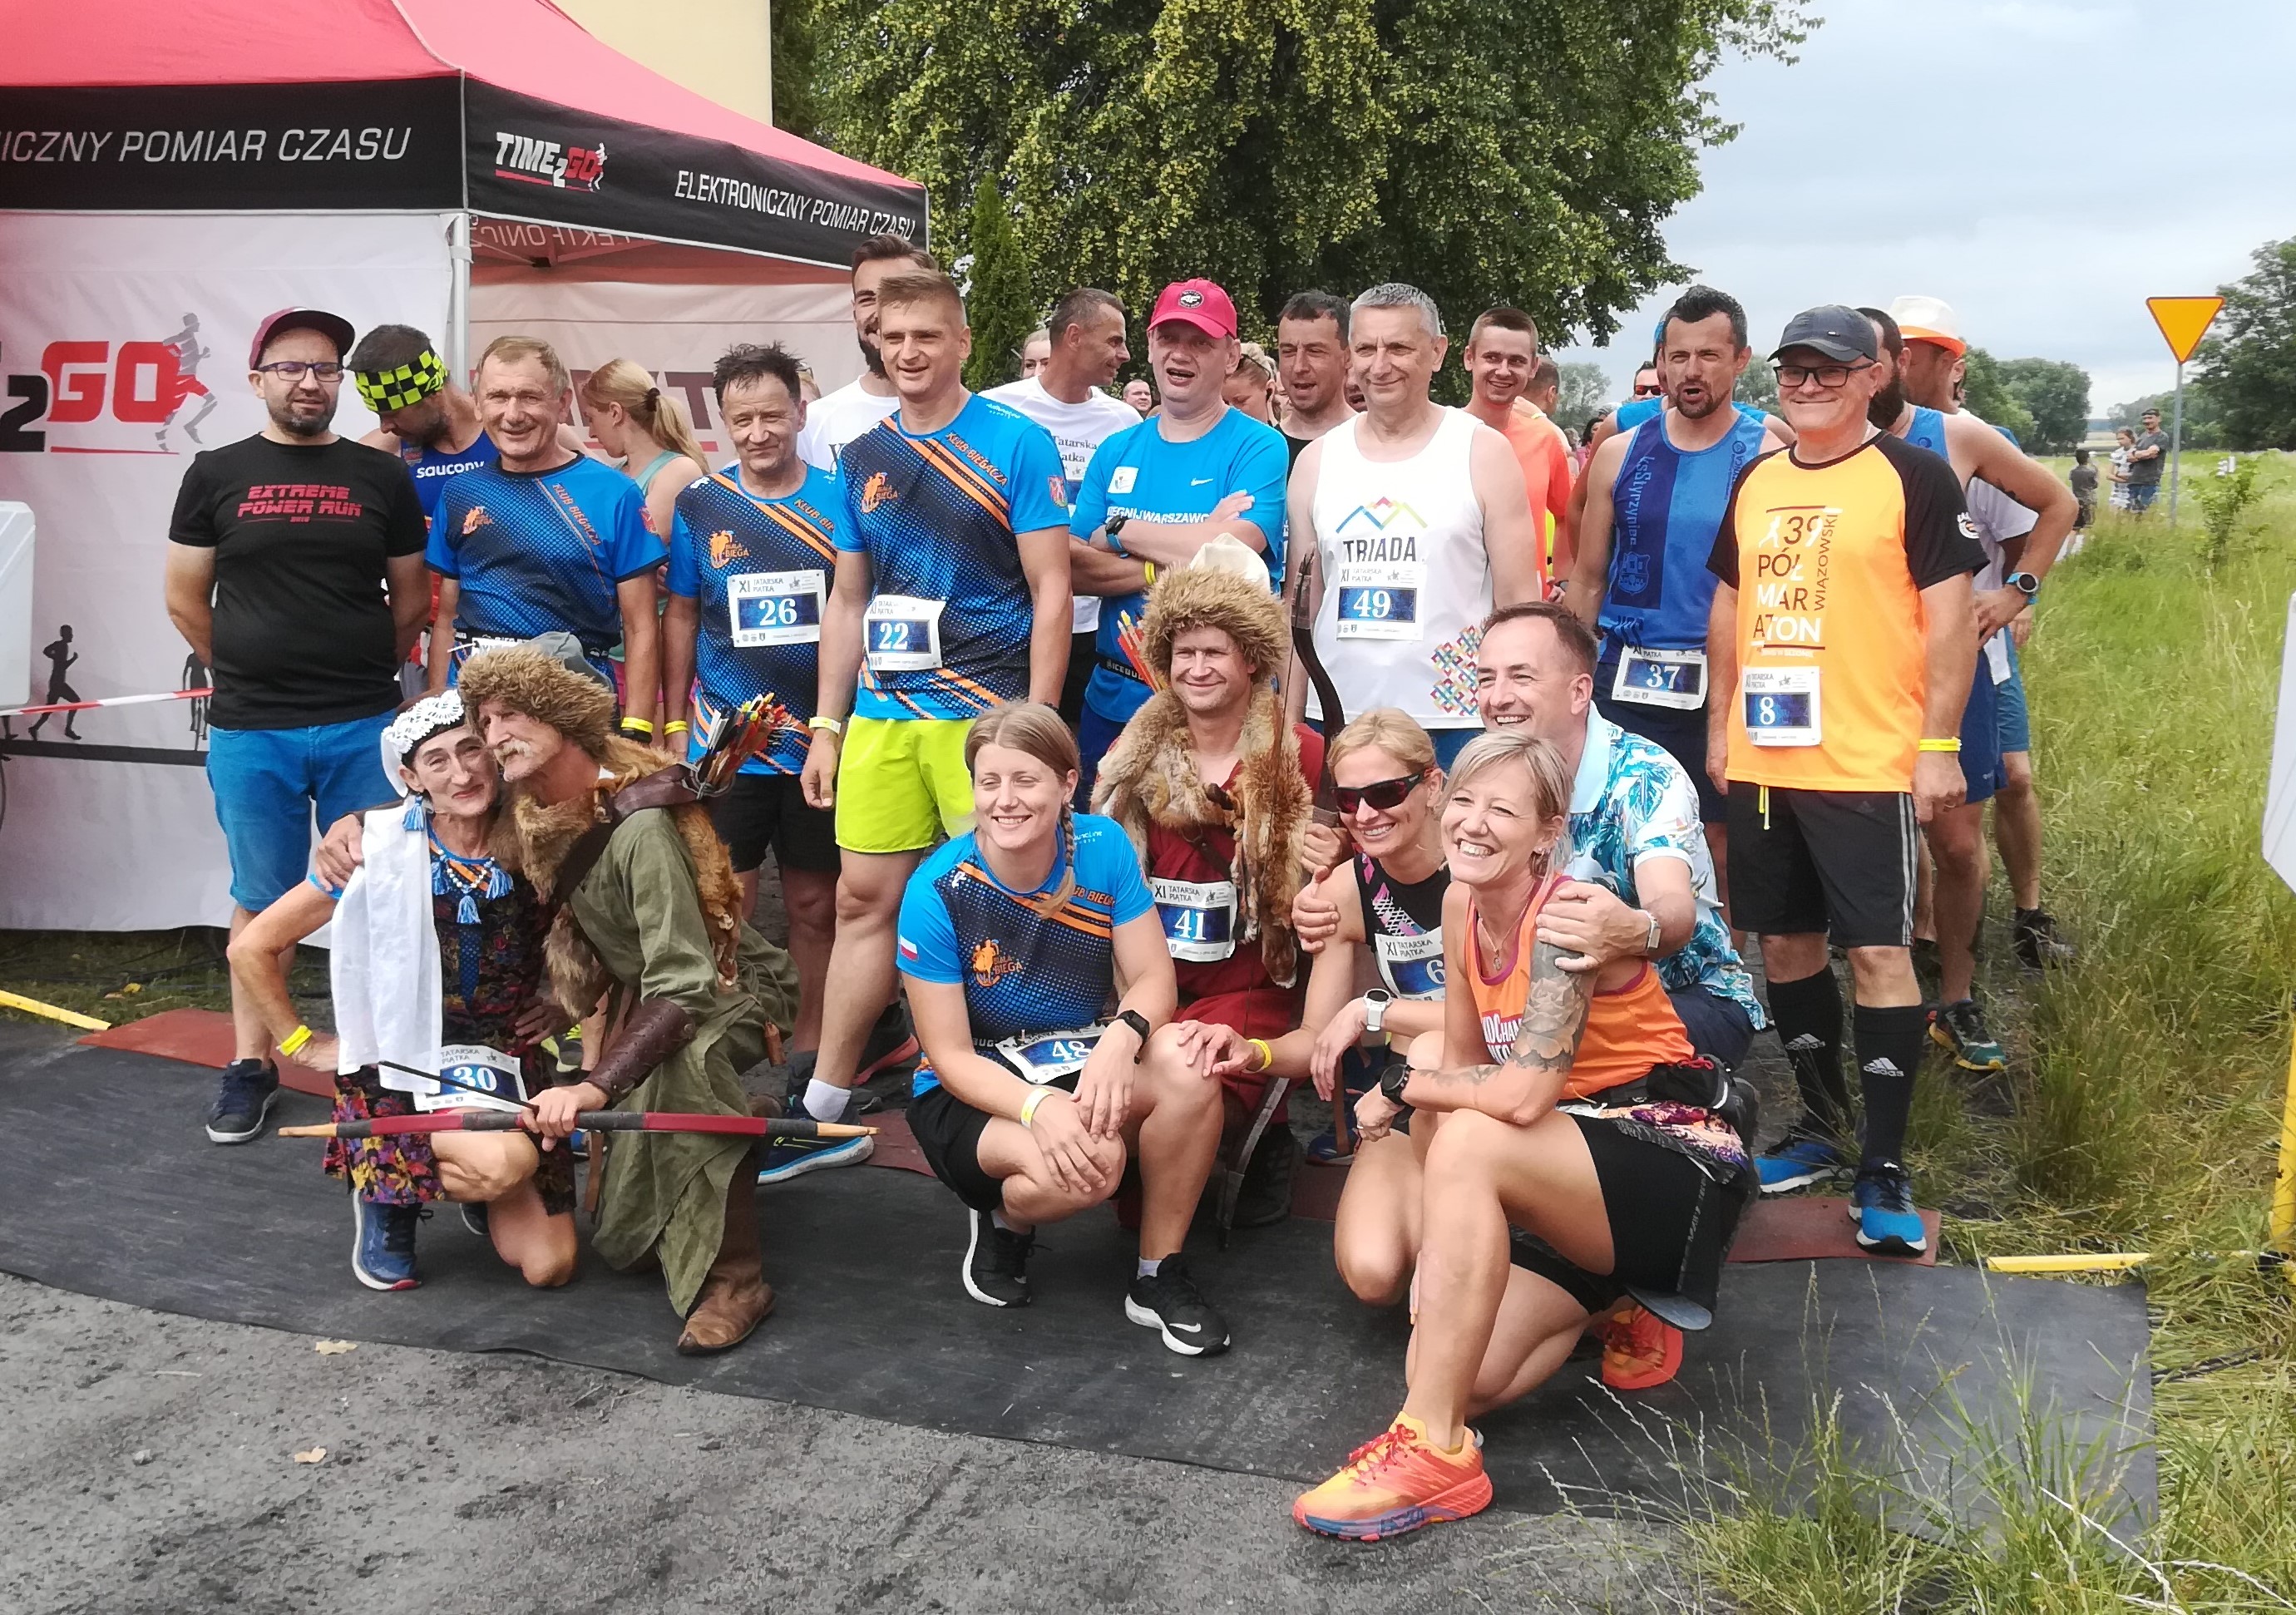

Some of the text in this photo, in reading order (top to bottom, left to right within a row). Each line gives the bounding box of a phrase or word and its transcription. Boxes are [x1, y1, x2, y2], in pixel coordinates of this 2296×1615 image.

[0, 126, 412, 163] ICZNY POMIAR CZASU
[674, 169, 916, 242] ELEKTRONICZNY POMIAR CZASU
[1061, 452, 1085, 462] atka
[248, 484, 351, 500] EXTREME
[237, 499, 363, 517] POWER RUN
[1783, 515, 1824, 548] 39
[1342, 536, 1417, 563] TRIADA
[1814, 514, 1839, 611] WIĄZOWSKI
[738, 580, 751, 593] XI
[1756, 582, 1809, 611] MAR
[758, 597, 797, 626] 26
[1353, 589, 1391, 619] 49
[878, 622, 909, 650] 22
[1752, 613, 1822, 644] ATON
[1646, 664, 1681, 689] 37
[1759, 696, 1775, 725] 8
[1154, 884, 1167, 899] XI
[1168, 885, 1201, 896] TATARSKA
[1168, 893, 1192, 902] PIĄTKA
[1173, 909, 1207, 941] 41
[1385, 939, 1434, 956] XI TATARSKA
[993, 961, 1024, 975] BIEGA
[441, 1049, 480, 1057] TATARSKA
[1052, 1040, 1092, 1062] 48
[453, 1066, 498, 1091] 30
[1863, 1064, 1905, 1077] adidas
